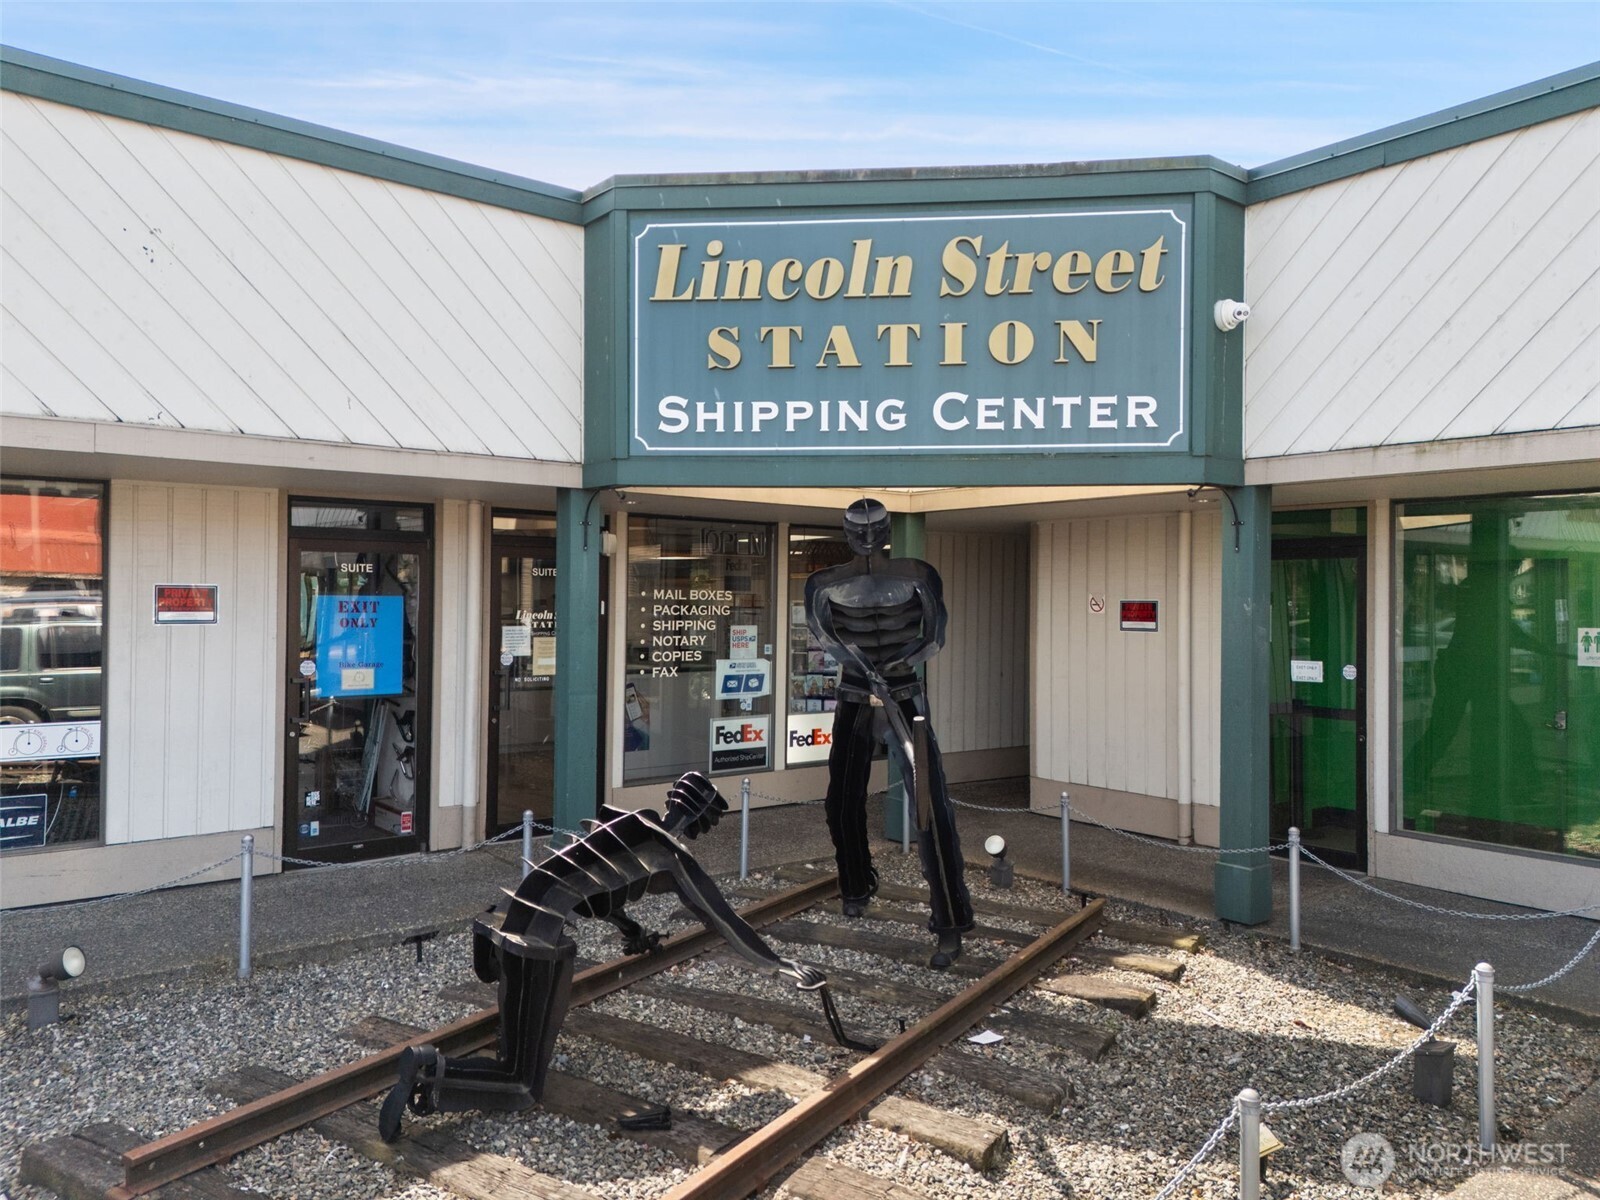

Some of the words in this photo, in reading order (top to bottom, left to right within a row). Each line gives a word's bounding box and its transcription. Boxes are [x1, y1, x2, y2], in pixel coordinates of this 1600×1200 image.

[649, 238, 914, 301] Lincoln
[939, 234, 1169, 298] Street
[707, 319, 1103, 370] STATION
[658, 395, 908, 434] SHIPPING
[932, 391, 1159, 432] CENTER
[340, 563, 374, 573] SUITE
[653, 589, 687, 600] MAIL
[689, 589, 733, 601] BOXES
[338, 600, 379, 613] EXIT
[653, 604, 731, 616] PACKAGING
[515, 609, 553, 620] Lincoln
[339, 617, 378, 628] ONLY
[653, 620, 716, 631] SHIPPING
[652, 635, 706, 647] NOTARY
[652, 651, 702, 663] COPIES
[652, 666, 679, 678] FAX
[715, 723, 764, 745] FedEx
[789, 728, 832, 748] FedEx
[714, 755, 739, 763] Authorized
[740, 752, 765, 761] ShipCenter
